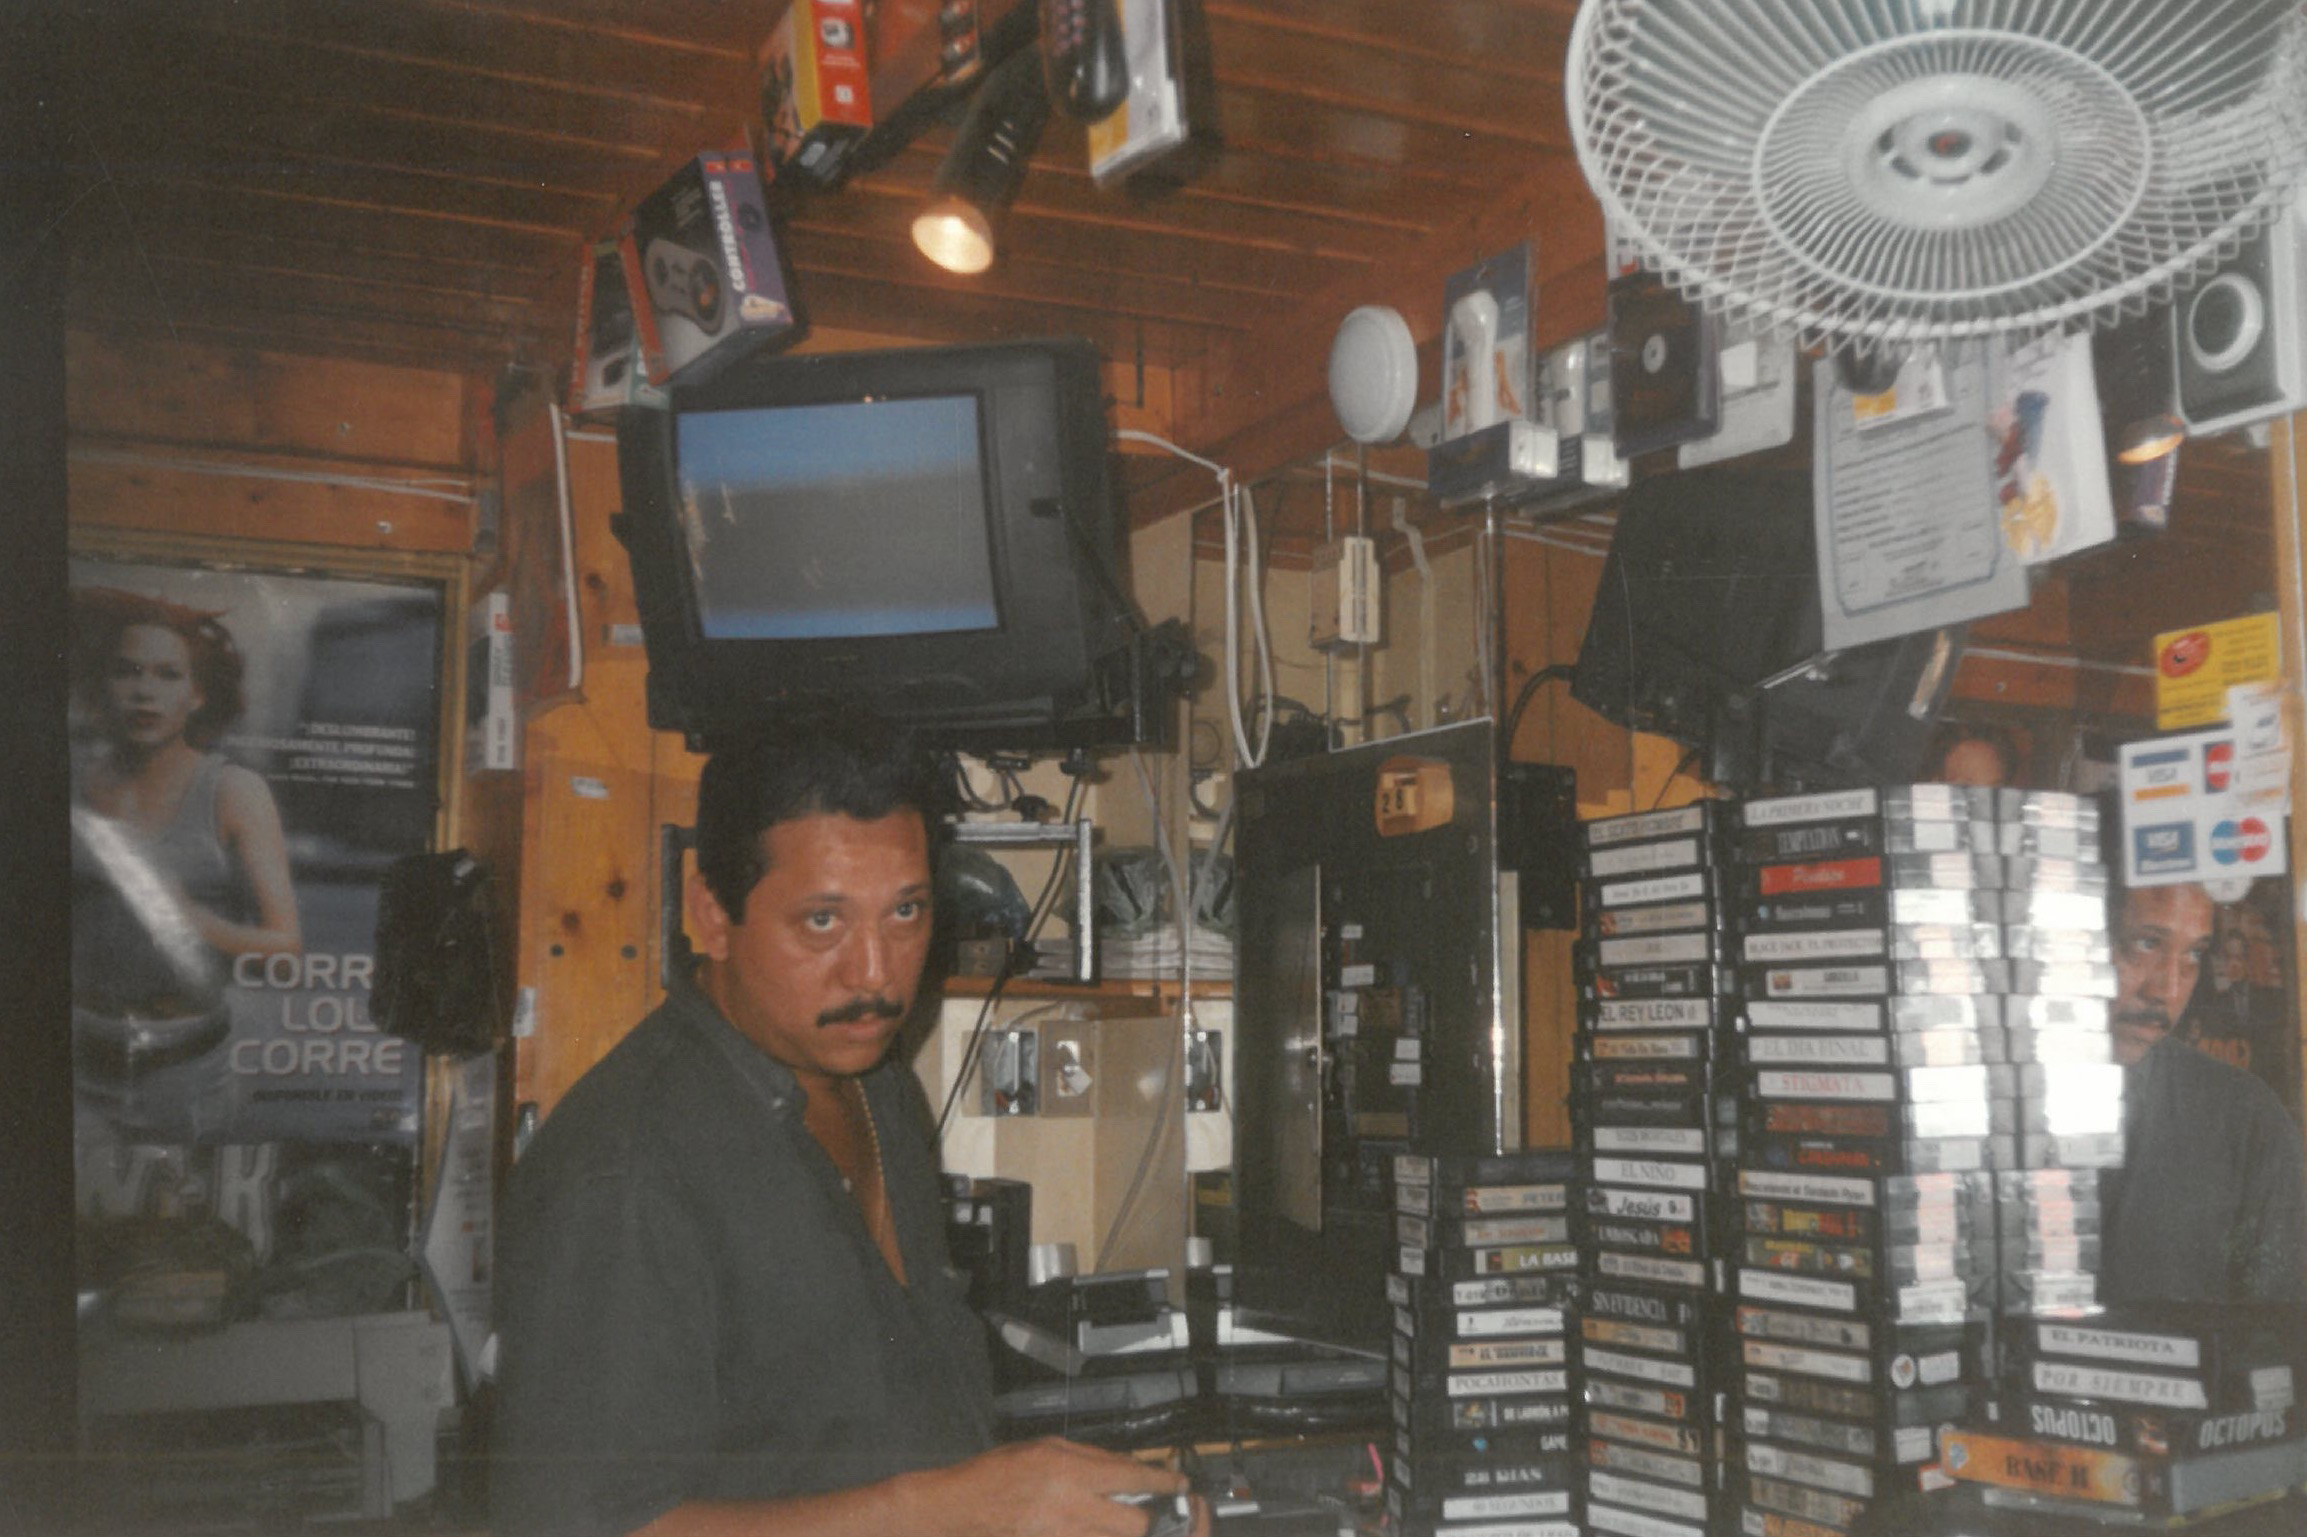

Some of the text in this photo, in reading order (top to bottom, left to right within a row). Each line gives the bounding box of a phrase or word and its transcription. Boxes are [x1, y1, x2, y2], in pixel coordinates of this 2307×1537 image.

[709, 180, 746, 292] CONTROLLER
[233, 951, 374, 990] CORR
[281, 996, 378, 1033] LOL
[1601, 1004, 1615, 1022] EL
[1619, 1004, 1644, 1022] REY
[1647, 1003, 1684, 1022] LEON
[229, 1037, 404, 1075] CORRE
[1781, 1073, 1866, 1093] STIGMATA
[1621, 1162, 1638, 1178] EL
[1519, 1253, 1539, 1268] LA
[2052, 1330, 2175, 1354] EL PATRIOTA
[1456, 1371, 1560, 1391] POCAHONTAS
[2041, 1369, 2183, 1398] POR SIEMPRE
[2031, 1404, 2118, 1446] OCTOPUS
[2200, 1411, 2287, 1449] OCTOPUS
